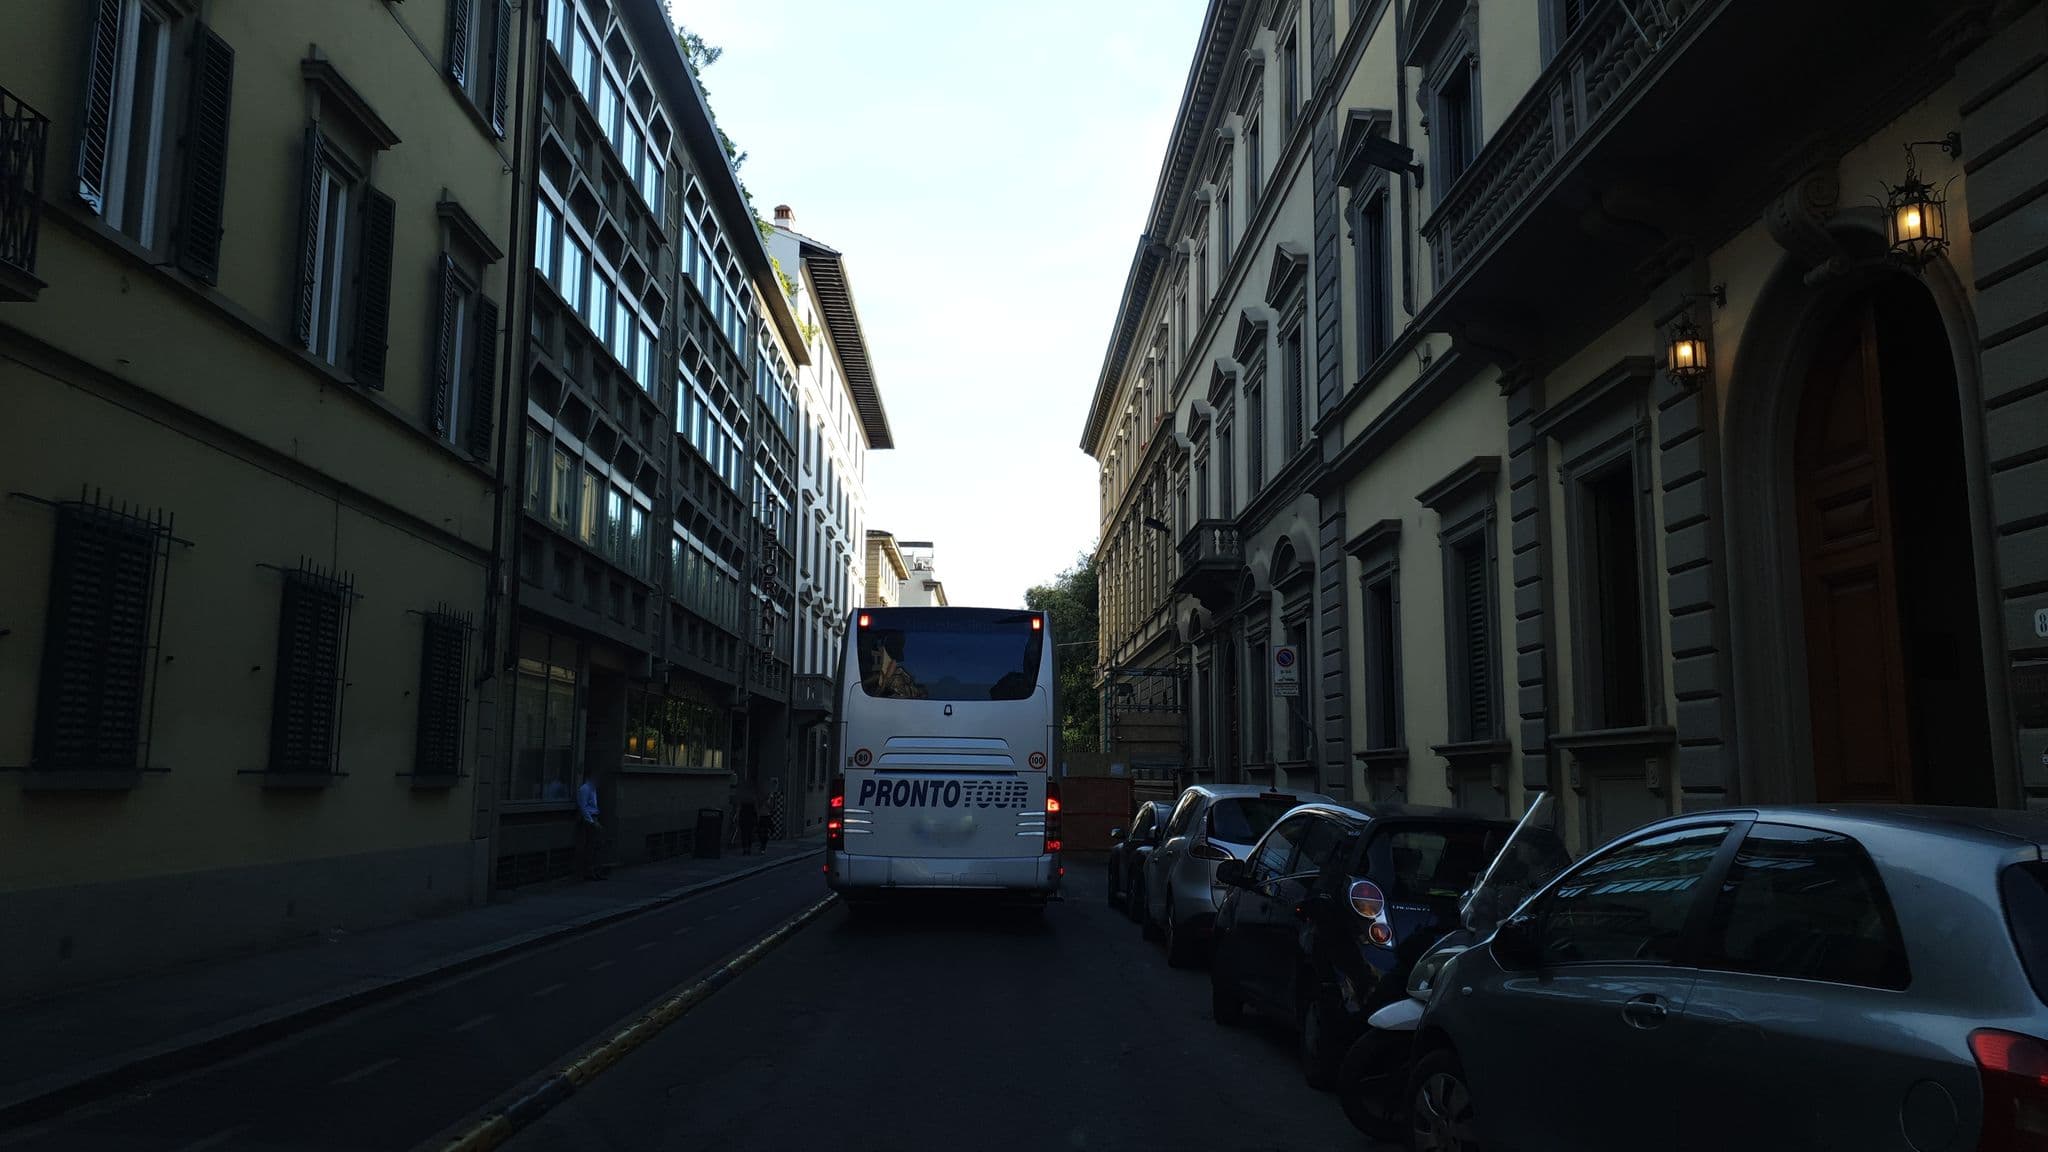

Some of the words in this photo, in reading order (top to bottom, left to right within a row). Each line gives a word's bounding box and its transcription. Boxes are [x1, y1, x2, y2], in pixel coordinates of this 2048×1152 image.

[761, 495, 778, 665] RISTORANTE
[859, 754, 868, 762] 80
[1031, 756, 1043, 765] 100
